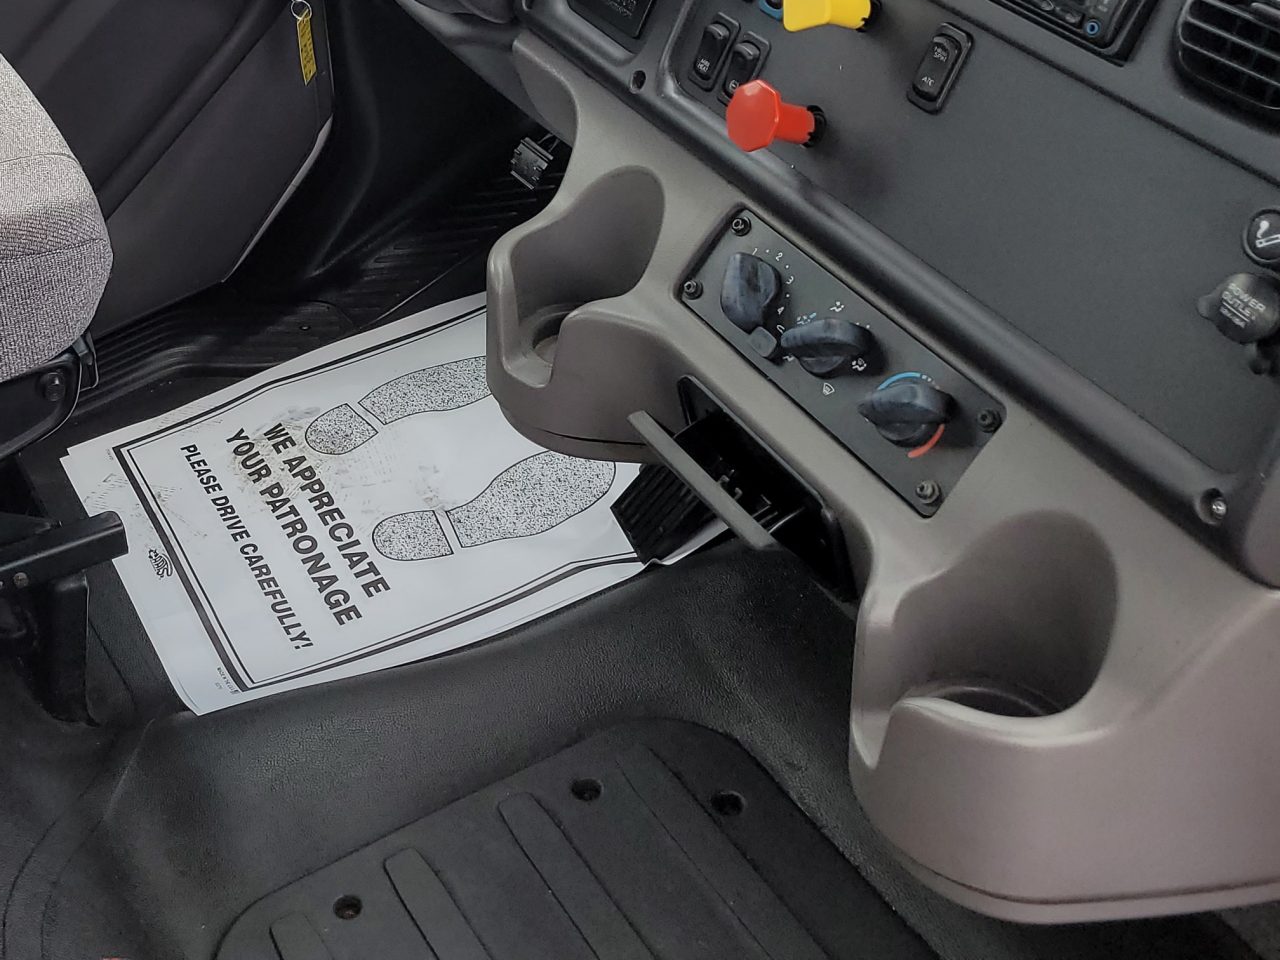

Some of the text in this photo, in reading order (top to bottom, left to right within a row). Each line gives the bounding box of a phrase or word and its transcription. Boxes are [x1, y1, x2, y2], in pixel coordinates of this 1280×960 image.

[921, 76, 935, 87] ATC
[752, 247, 758, 255] 1
[775, 252, 783, 261] 2
[785, 275, 794, 285] 3
[1228, 282, 1266, 312] POWER
[777, 306, 785, 315] 4
[263, 422, 391, 598] WE APPRECIATE
[226, 428, 362, 626] YOUR PATRONAGE
[180, 443, 314, 650] PLEASE DRIVE CAREFULLY!
